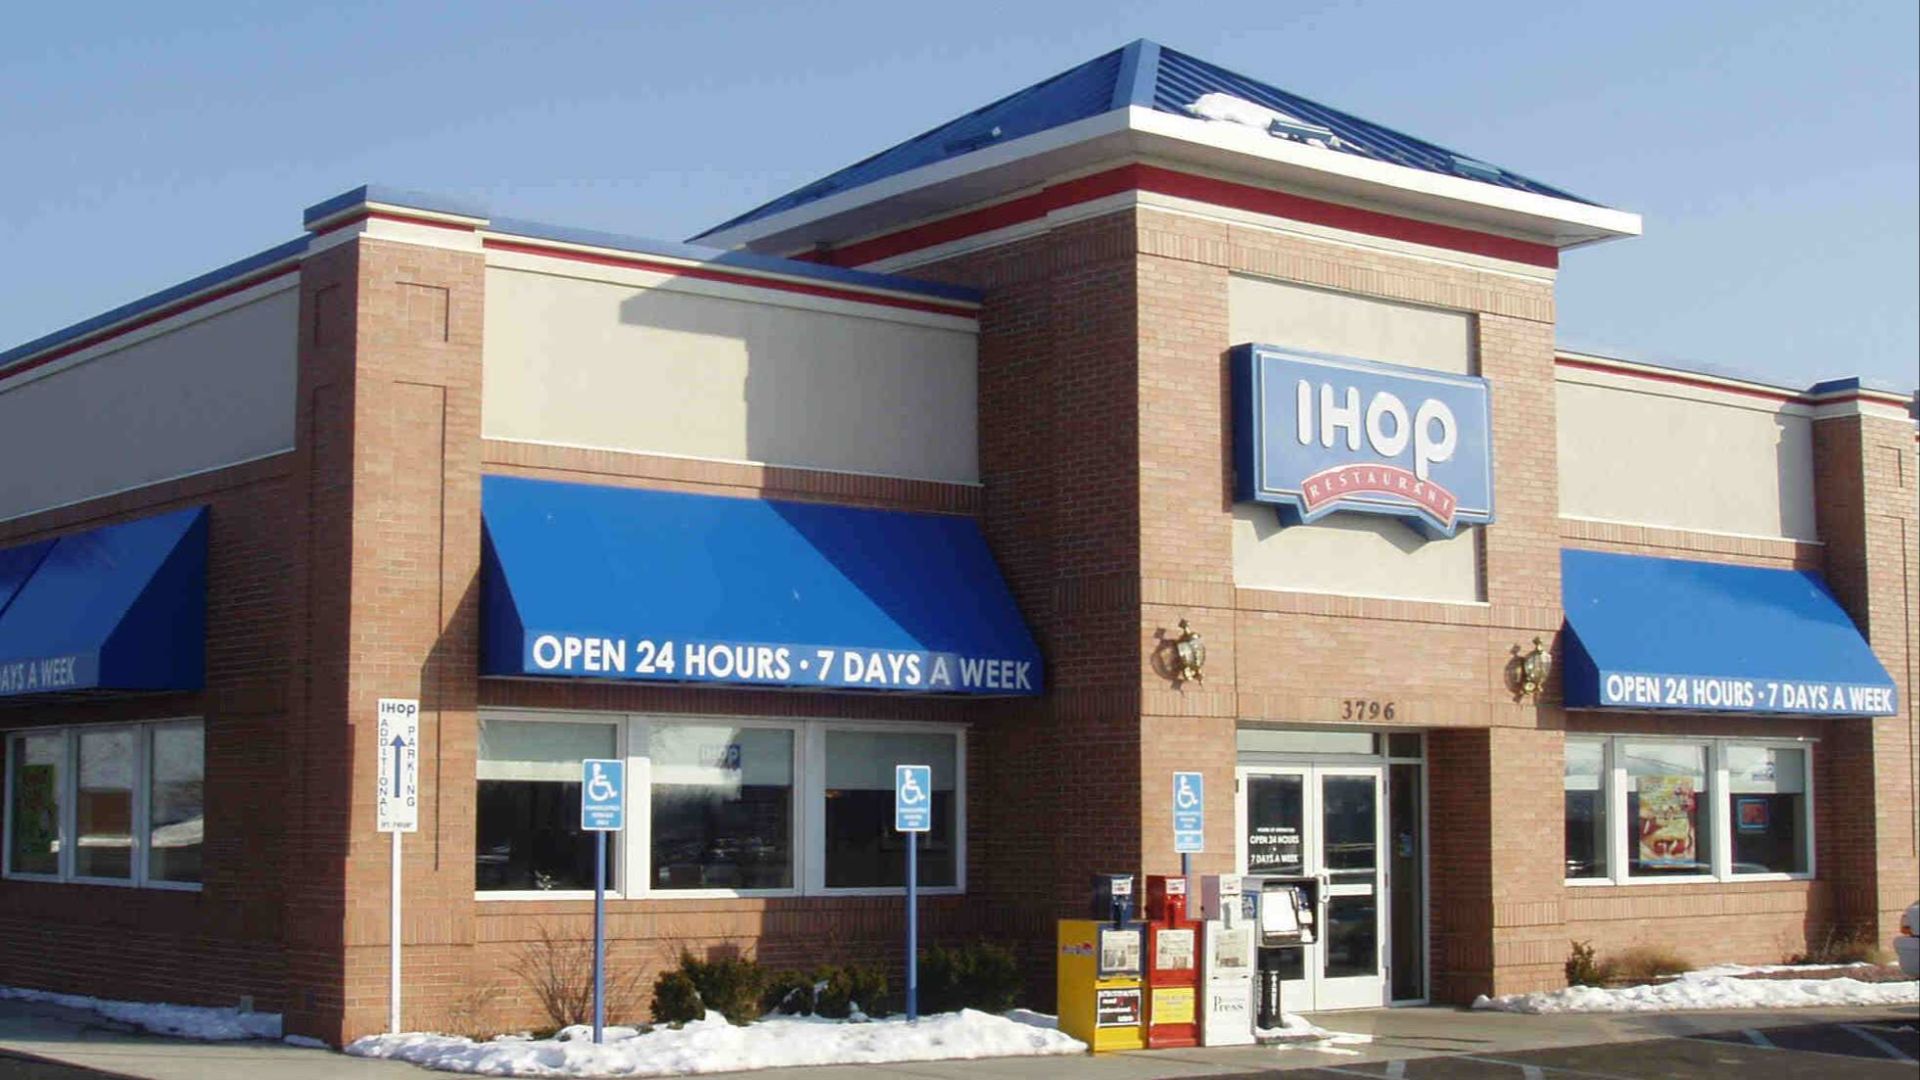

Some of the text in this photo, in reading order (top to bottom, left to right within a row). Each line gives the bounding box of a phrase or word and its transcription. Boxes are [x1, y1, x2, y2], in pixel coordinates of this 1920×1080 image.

[0, 656, 77, 691] AYS A WEEK
[533, 635, 1031, 690] OPEN 24 HOURS 7 DAYS A WEEK
[1342, 700, 1395, 720] 3796
[1606, 674, 1893, 712] OPEN 24 HOURS 7 DAYS A WEEK
[379, 718, 389, 816] ADDITIONAL
[407, 725, 416, 807] PARKING
